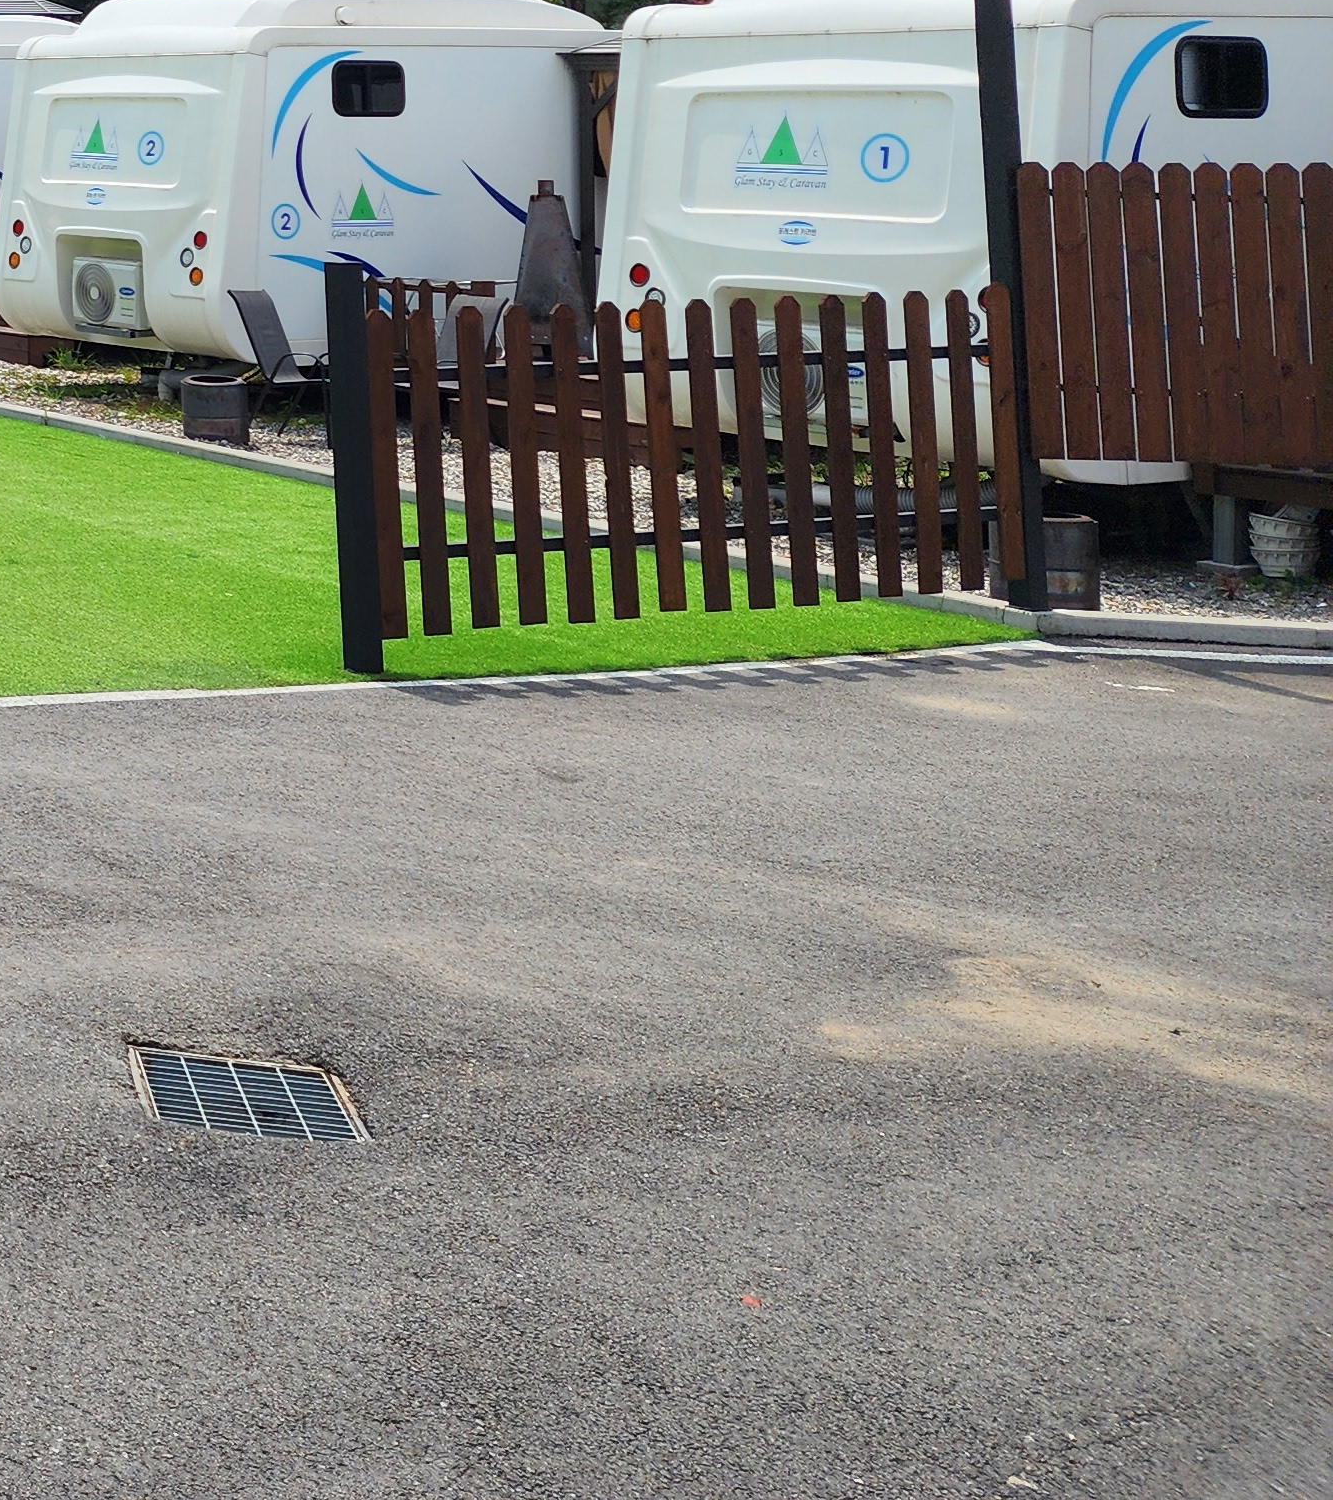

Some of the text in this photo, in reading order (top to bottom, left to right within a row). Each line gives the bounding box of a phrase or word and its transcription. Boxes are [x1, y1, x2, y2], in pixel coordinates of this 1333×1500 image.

[145, 139, 156, 156] 2
[880, 146, 890, 169] 1
[734, 175, 755, 188] Glam
[756, 177, 777, 190] Stay
[789, 177, 827, 190] Caravan
[280, 212, 291, 231] 2
[331, 229, 347, 239] Glam
[348, 229, 362, 239] Stay
[370, 229, 394, 238] Caravan
